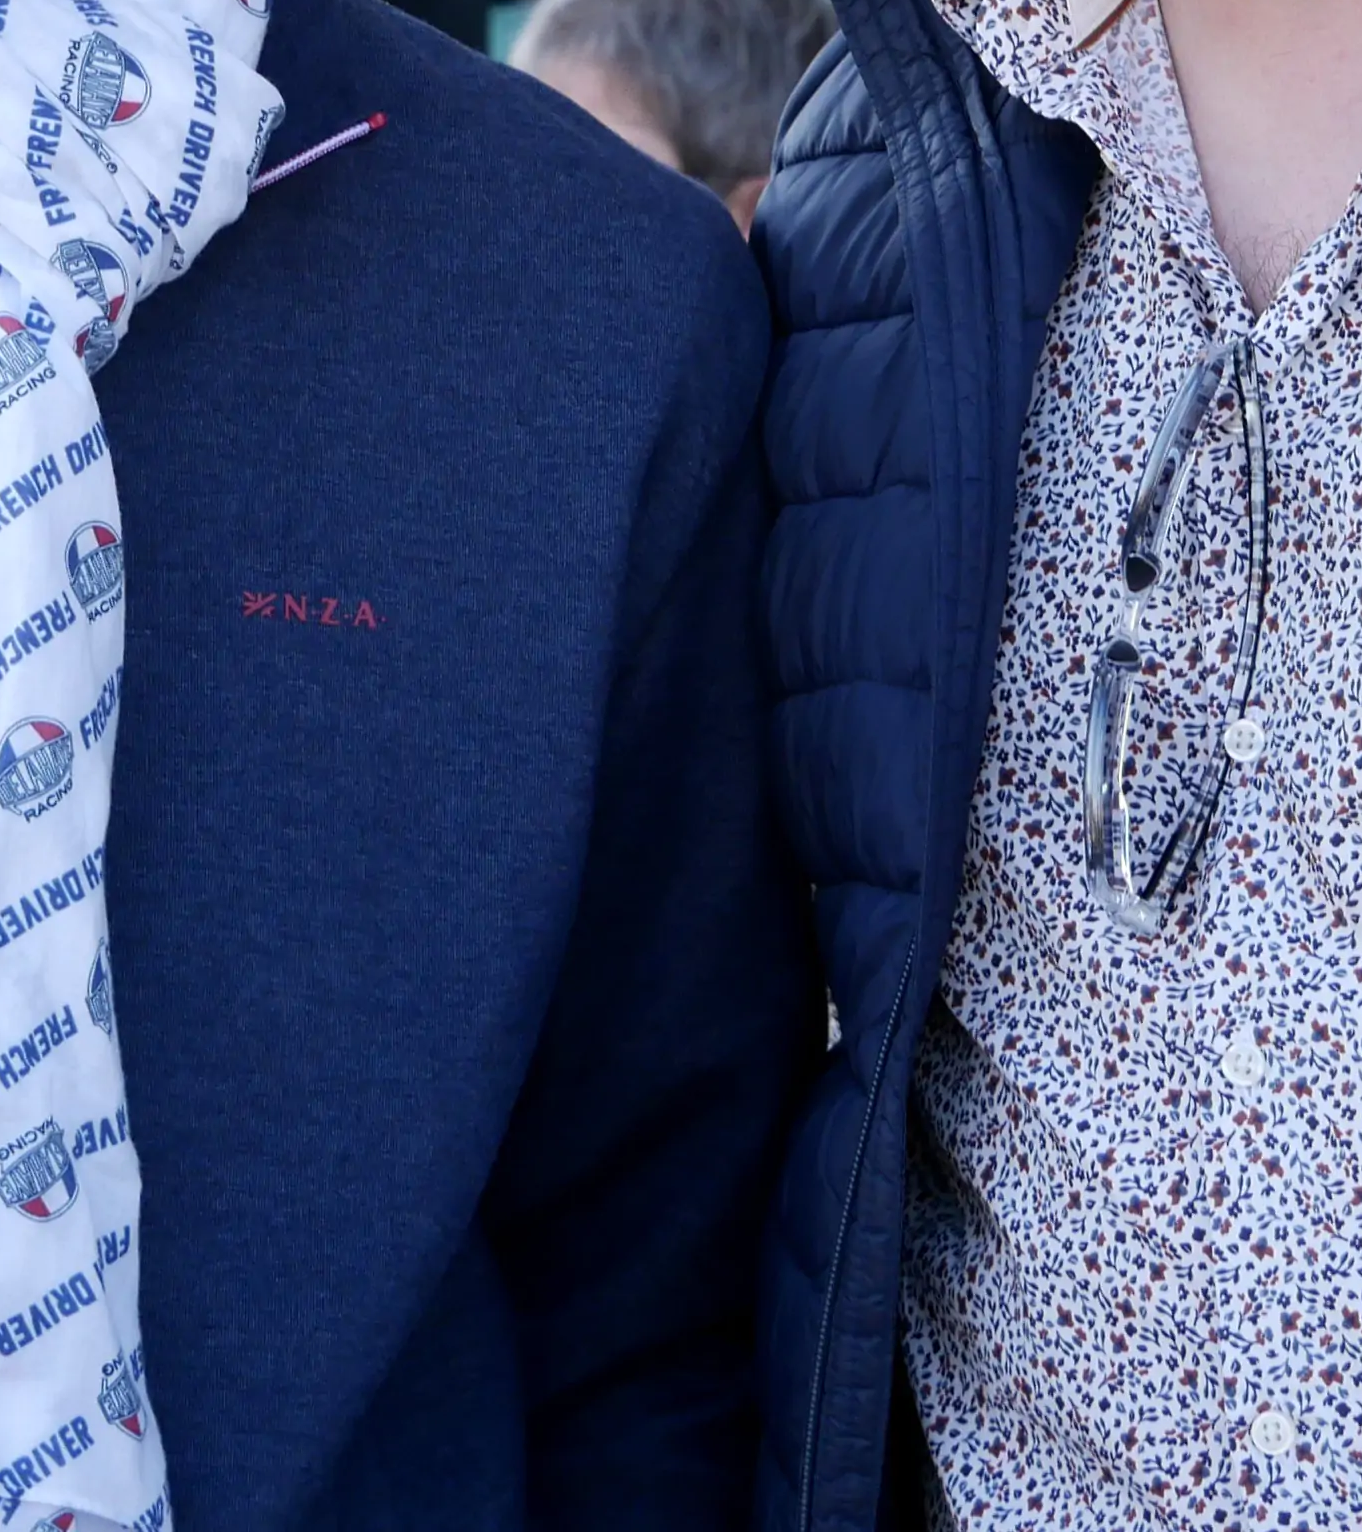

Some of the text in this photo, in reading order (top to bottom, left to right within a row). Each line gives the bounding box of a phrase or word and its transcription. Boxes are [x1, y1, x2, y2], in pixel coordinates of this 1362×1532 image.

[58, 38, 82, 106] RACING
[164, 118, 215, 229] DRIVER
[24, 776, 74, 824] RACING
